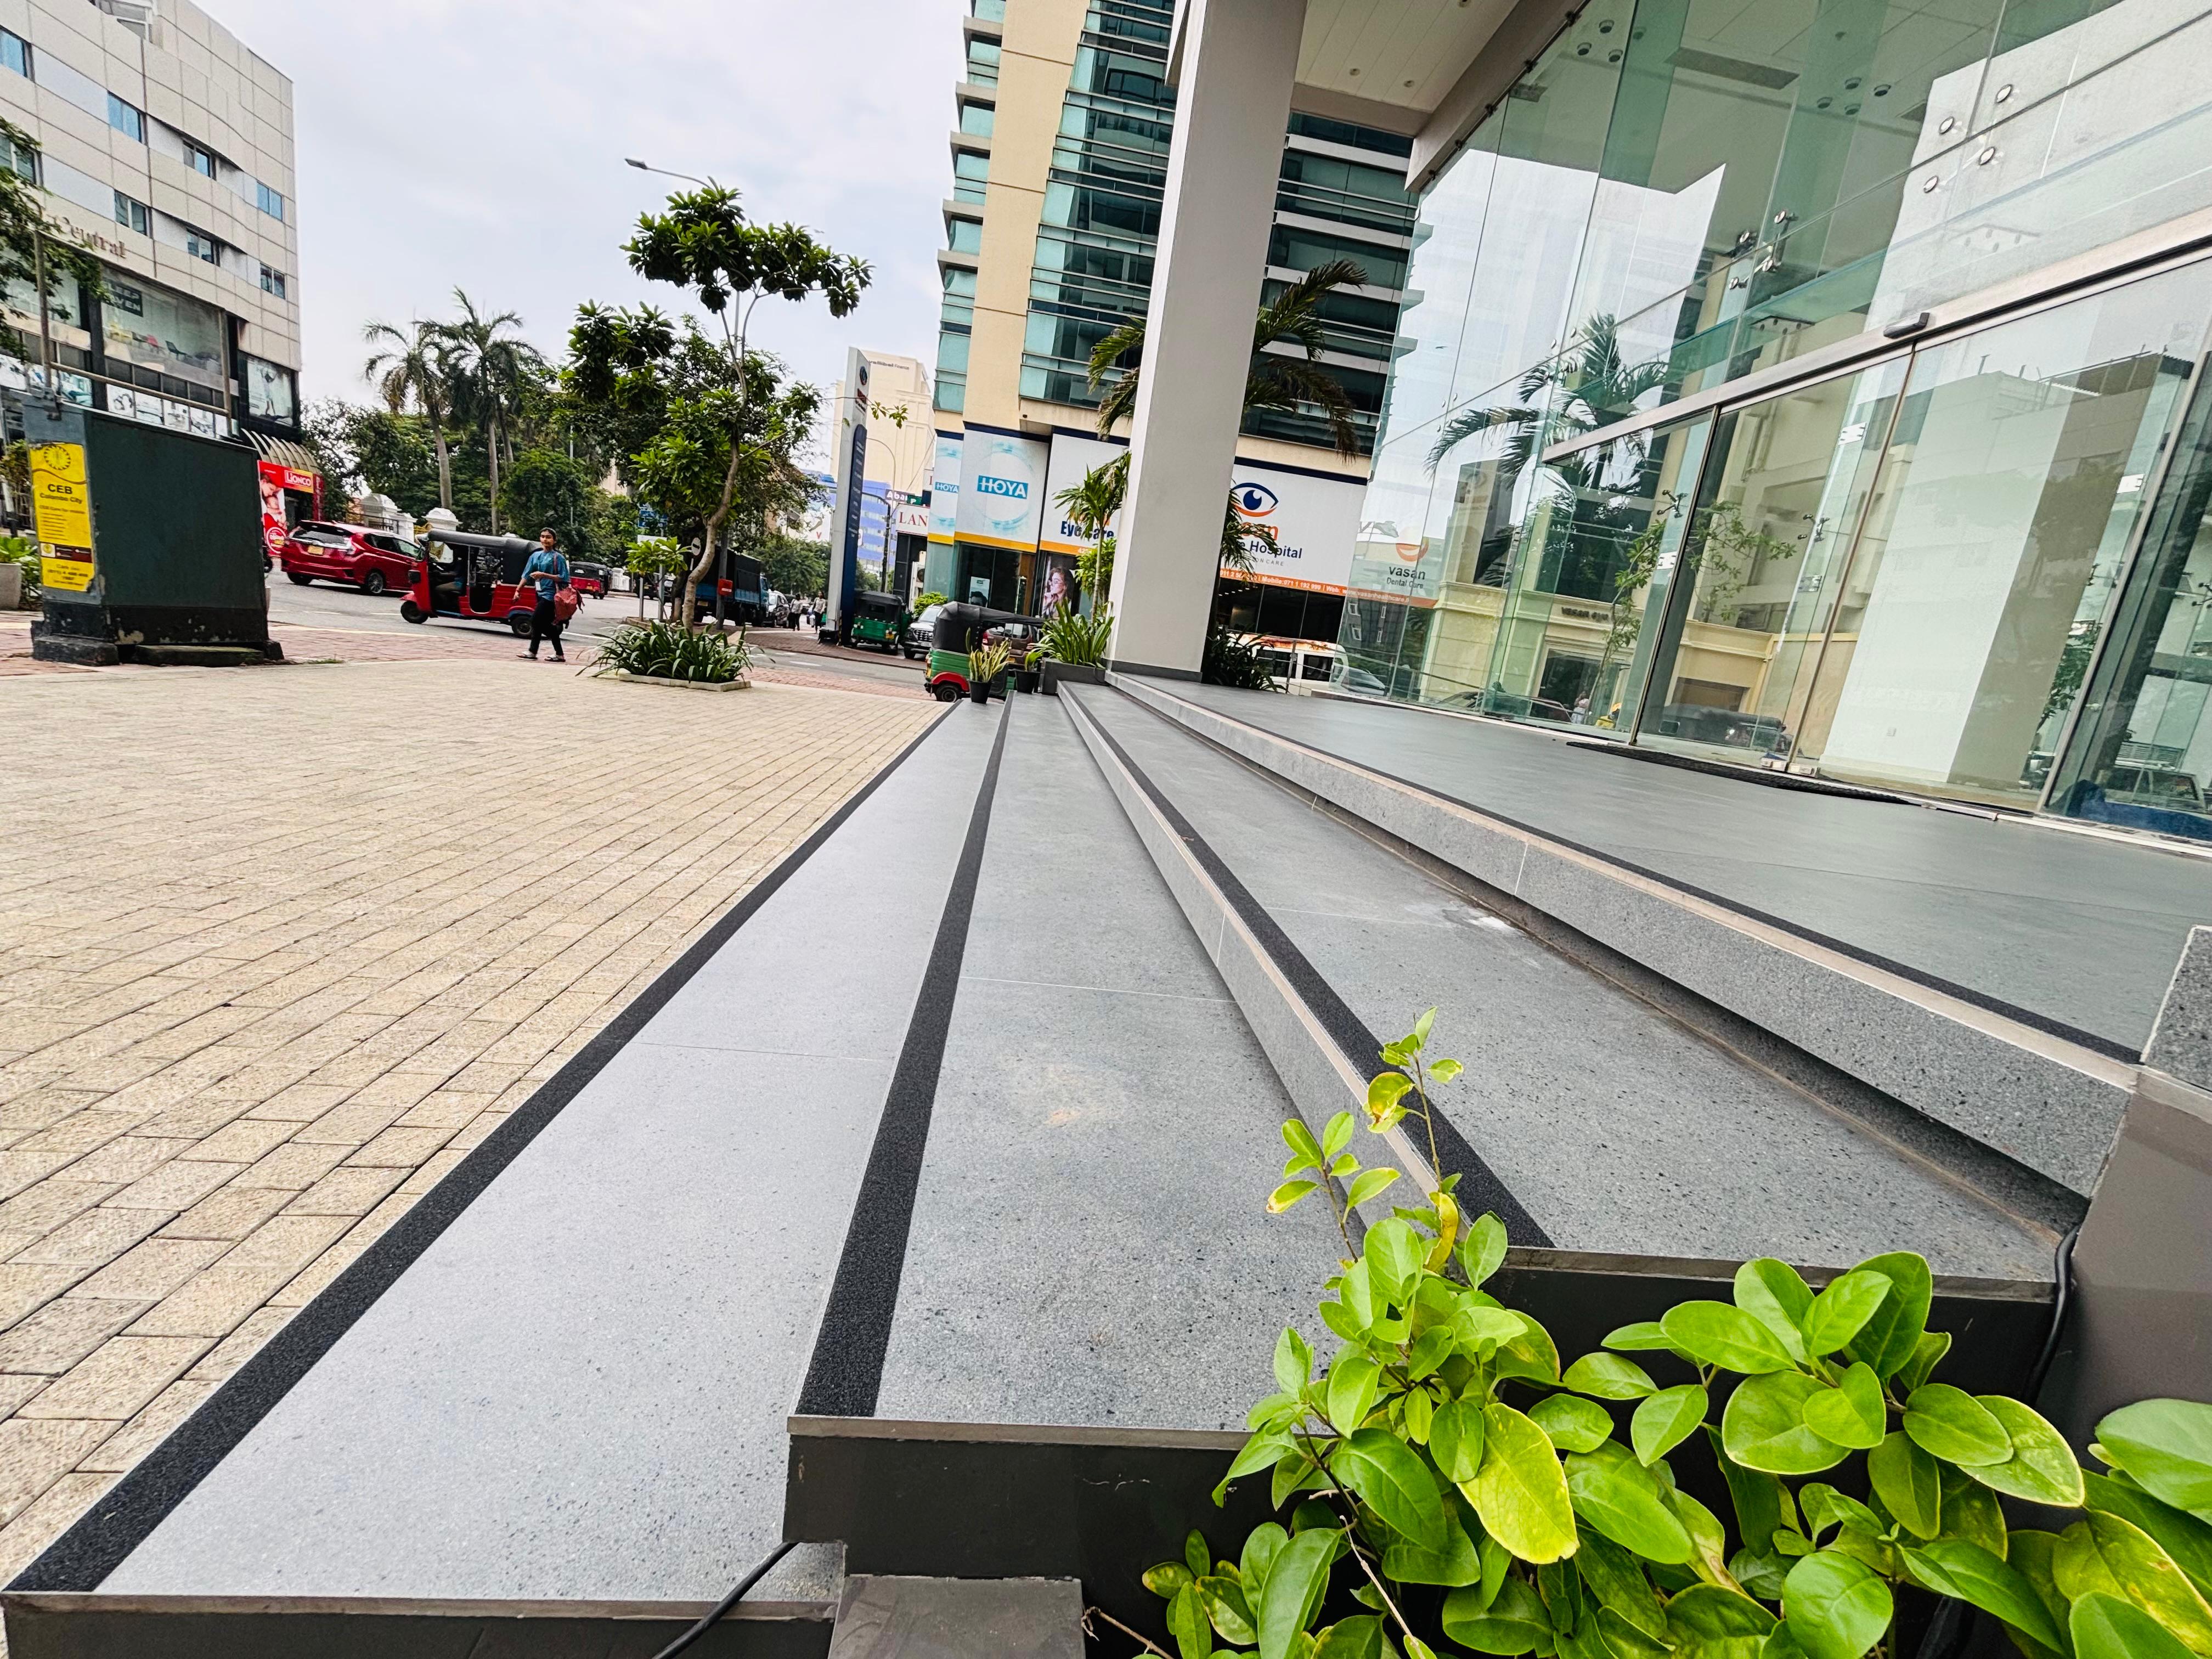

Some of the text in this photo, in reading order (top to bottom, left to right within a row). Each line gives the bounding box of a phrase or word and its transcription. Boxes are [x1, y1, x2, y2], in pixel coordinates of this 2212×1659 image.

[48, 484, 72, 494] CEB
[936, 483, 959, 493] HOYA
[979, 477, 1026, 498] HOYA
[1250, 540, 1302, 558] Hospital
[1389, 566, 1426, 580] vasan
[1386, 577, 1407, 586] Dental
